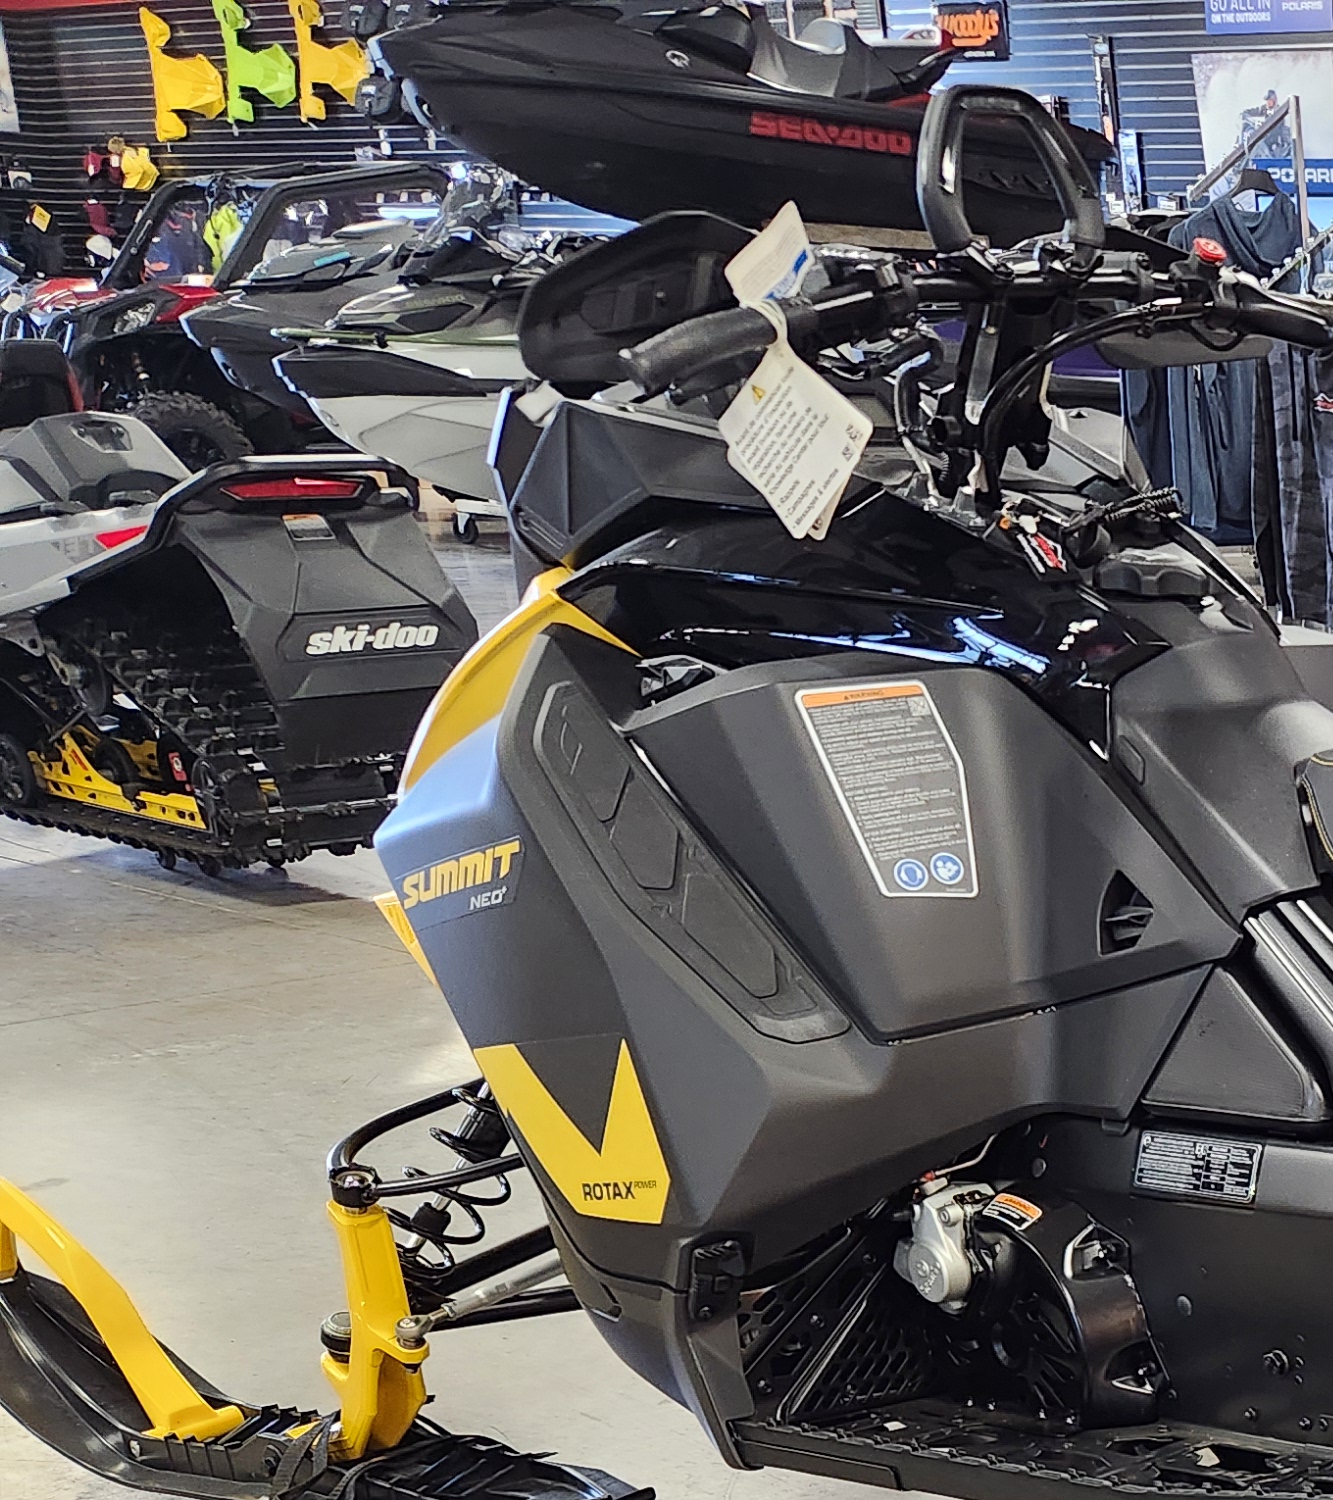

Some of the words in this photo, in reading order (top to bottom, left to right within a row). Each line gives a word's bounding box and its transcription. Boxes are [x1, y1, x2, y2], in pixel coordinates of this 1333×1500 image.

[1282, 1, 1323, 11] POLARIS
[1211, 14, 1222, 24] ON
[1222, 13, 1235, 23] THE
[1235, 11, 1271, 23] OUTDOORS
[306, 622, 439, 655] ski-doo
[404, 840, 521, 909] SUMMIT
[582, 1180, 636, 1202] ROTAX
[634, 1180, 657, 1189] POWER
